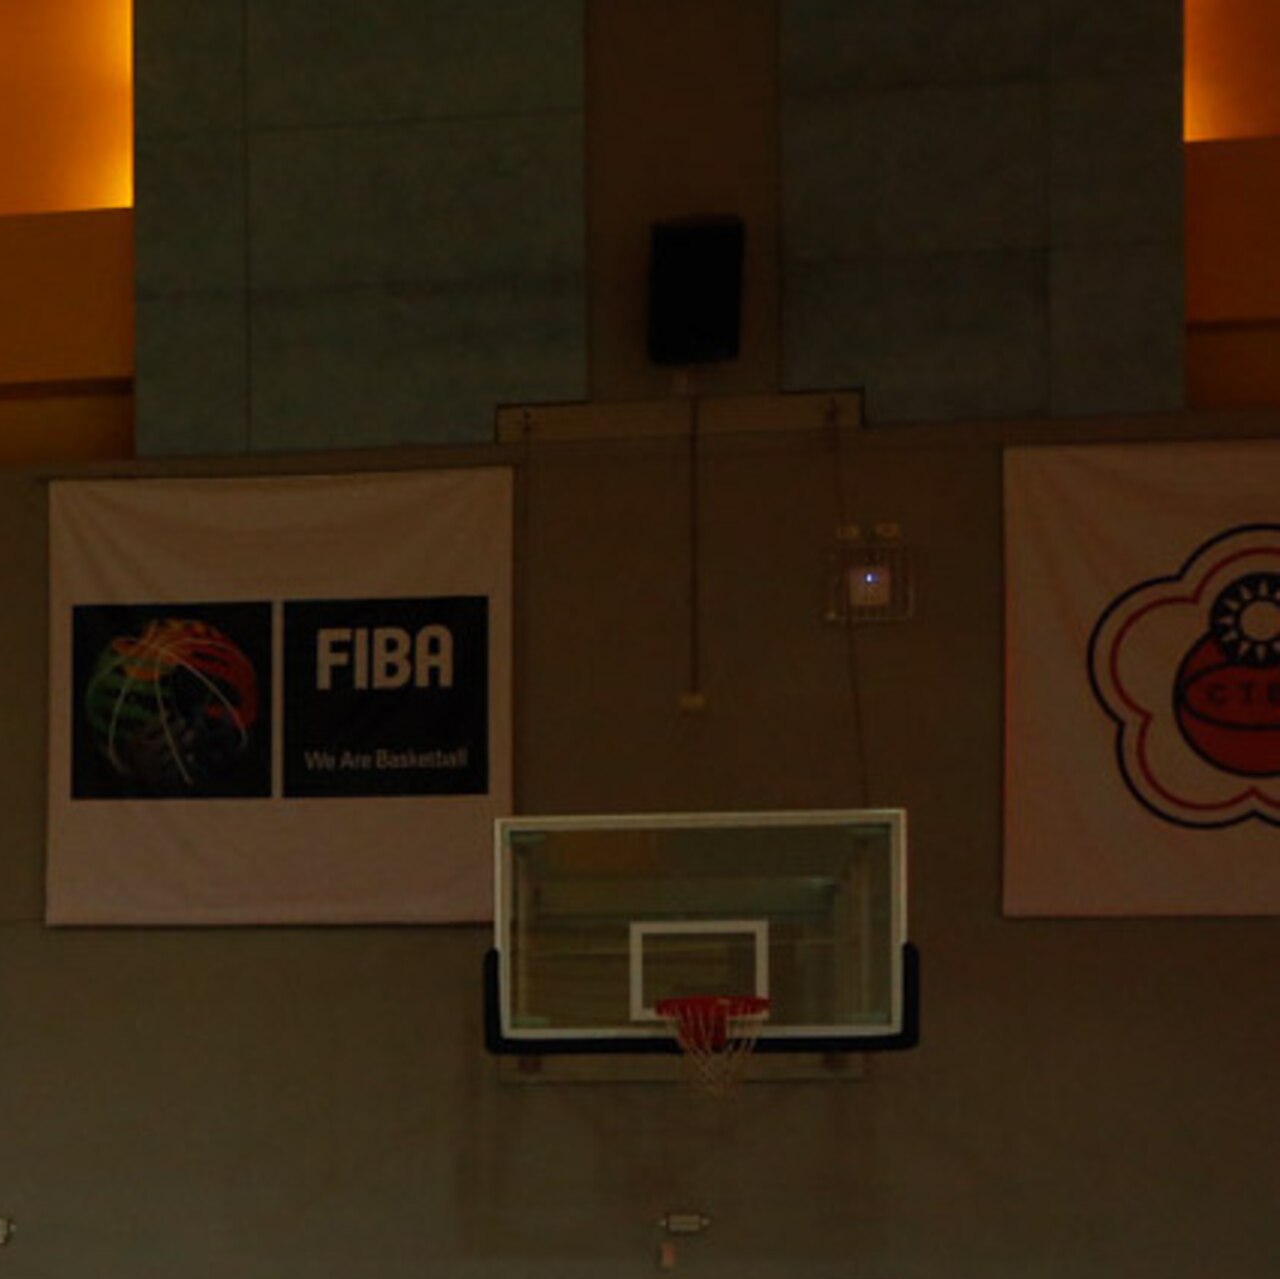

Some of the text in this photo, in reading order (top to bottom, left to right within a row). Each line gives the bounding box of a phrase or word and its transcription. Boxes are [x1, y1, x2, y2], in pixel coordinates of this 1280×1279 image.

[315, 622, 454, 691] FIBA
[304, 746, 469, 771] We Are Basketball
